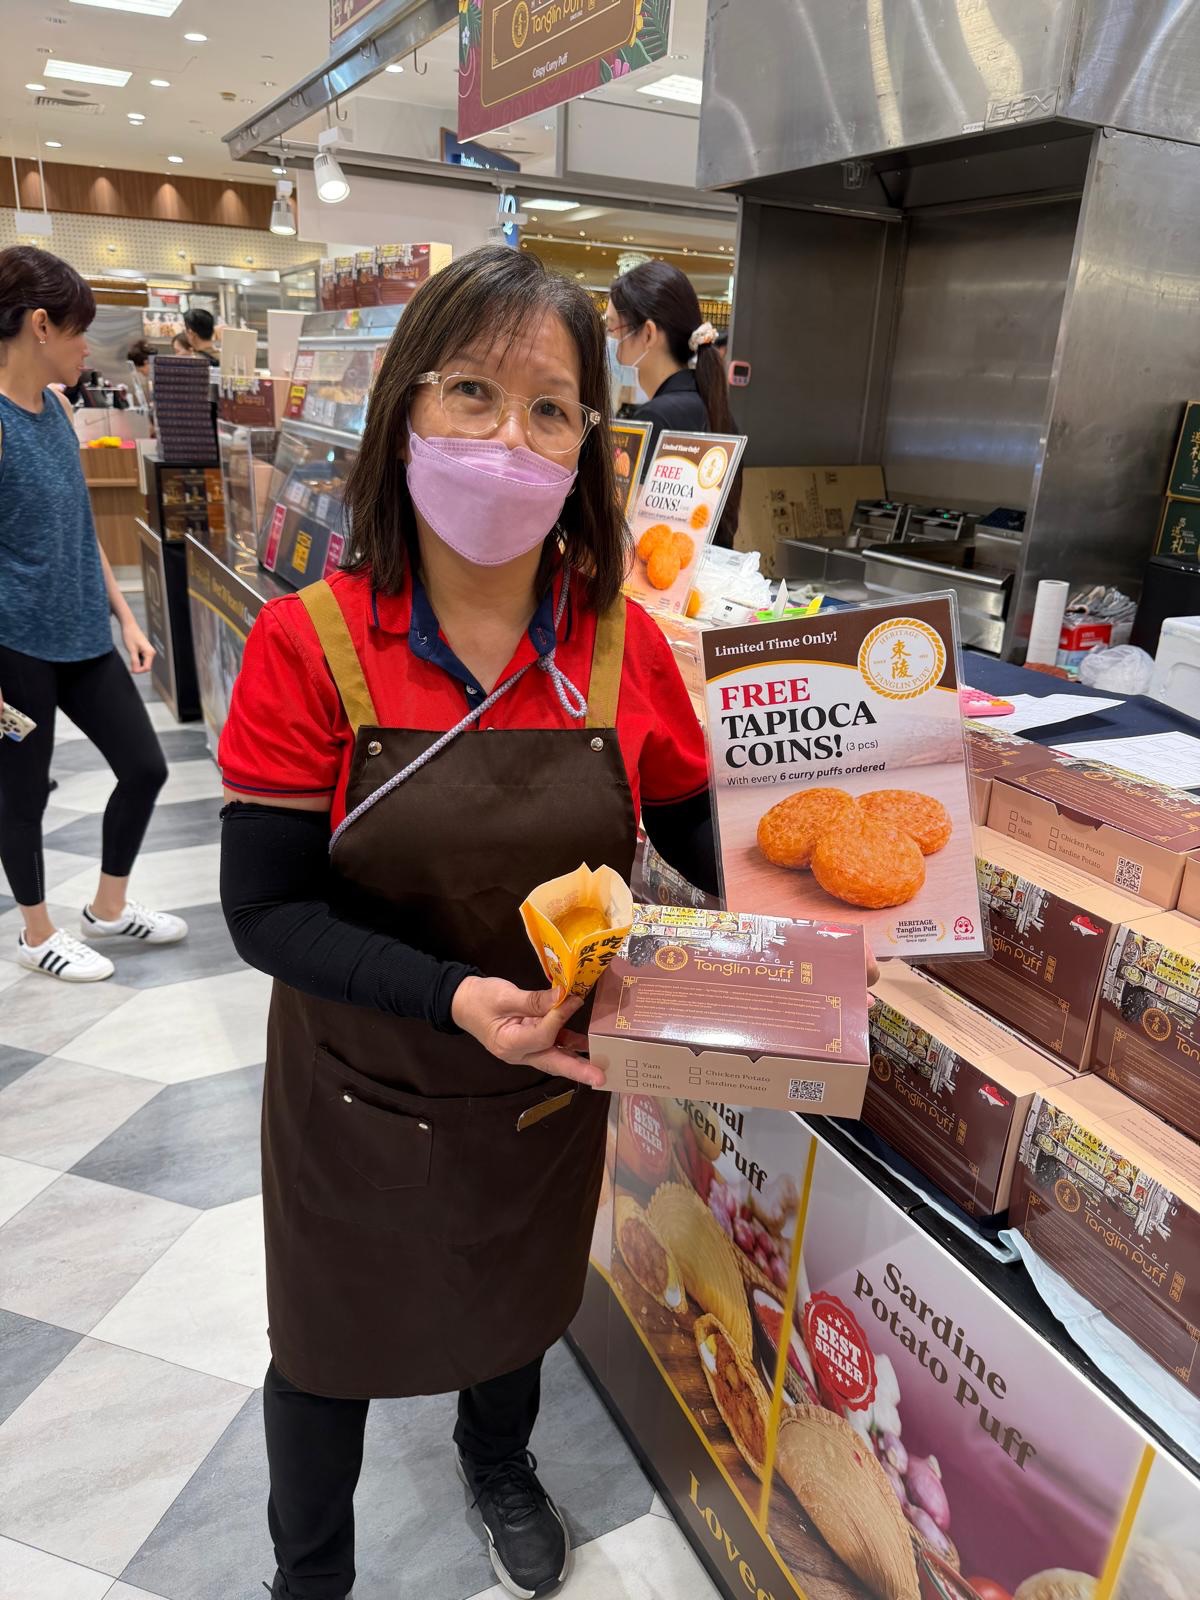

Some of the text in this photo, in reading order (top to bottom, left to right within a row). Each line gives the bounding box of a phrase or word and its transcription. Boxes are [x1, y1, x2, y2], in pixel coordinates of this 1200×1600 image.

[532, 52, 569, 79] Crispy Curry Puff
[654, 465, 683, 480] FREE
[650, 480, 694, 499] TAPIOCA
[645, 494, 681, 512] COINS!
[715, 631, 838, 657] Limited Time Only!
[880, 629, 921, 645] HERITAGE
[875, 666, 931, 689] TANGLIN PUFF
[720, 677, 811, 711] FREE
[721, 700, 877, 740] TAPIOCA
[725, 734, 879, 769] COINS! (3 pcs)
[727, 762, 885, 785] With every 6 curry puffs ordered
[1020, 816, 1033, 826] Yam
[1060, 833, 1105, 857] Chicken Potato
[1058, 846, 1101, 869] Sardine Potato
[896, 926, 922, 934] Tanglin
[898, 919, 934, 927] HERITAGE
[993, 925, 1044, 957] RITAGE
[694, 950, 794, 966] HERITAGE
[993, 937, 1012, 955] glin
[1013, 948, 1042, 971] Puff
[694, 959, 794, 979] Tanglin Puff
[642, 1062, 661, 1070] Yam
[642, 1071, 663, 1080] Otah
[705, 1069, 771, 1083] Chicken Potato
[642, 1081, 671, 1090] Others
[705, 1079, 767, 1092] Sardine Potato
[895, 1078, 927, 1112] Tanglin
[928, 1106, 954, 1132] Puff
[634, 1105, 661, 1137] BEST
[706, 1101, 744, 1139] nal
[633, 1120, 663, 1152] SELLER
[719, 1130, 768, 1193] Puff
[1084, 1209, 1129, 1256] Tanglin
[1131, 1250, 1167, 1284] Puff
[816, 1315, 861, 1367] BEST
[883, 1262, 1007, 1400] Sardine
[815, 1335, 864, 1387] SELLER
[852, 1269, 1037, 1473] Potato Puff
